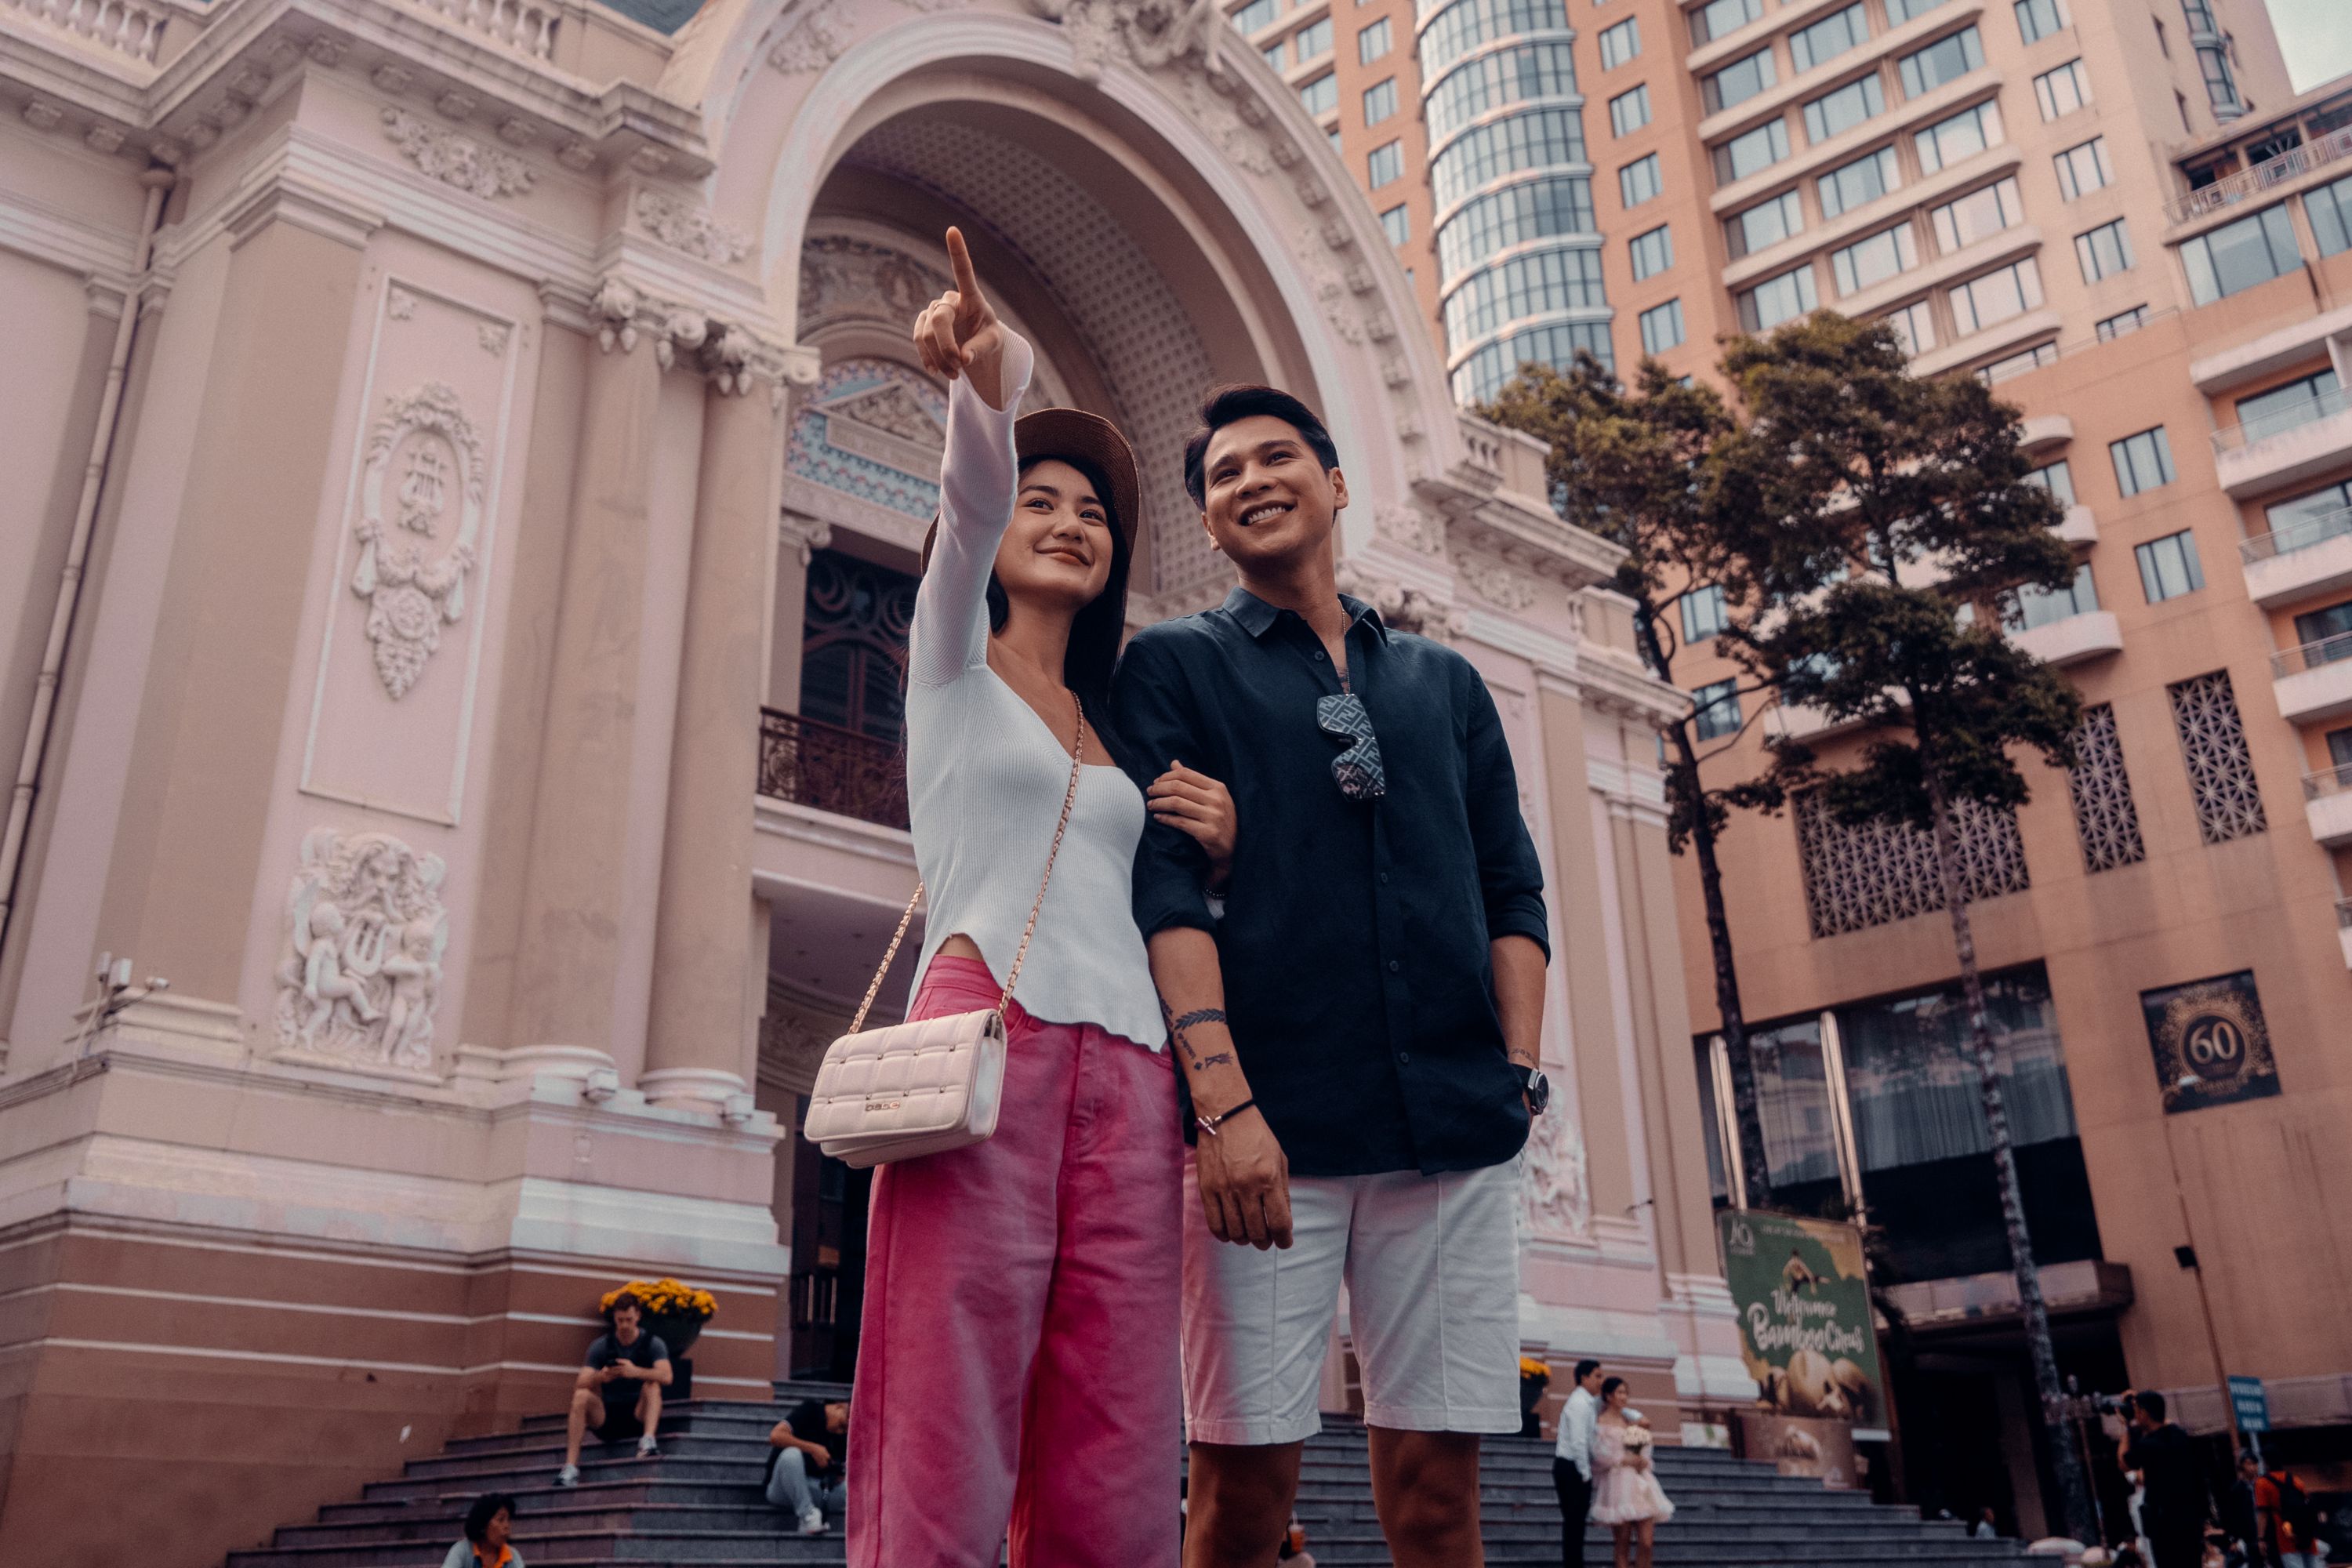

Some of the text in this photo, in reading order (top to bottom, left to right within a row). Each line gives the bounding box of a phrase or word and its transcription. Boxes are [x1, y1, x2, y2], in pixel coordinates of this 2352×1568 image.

[2190, 1022, 2238, 1065] 60
[1747, 1301, 1865, 1355] Bamboo Circus
